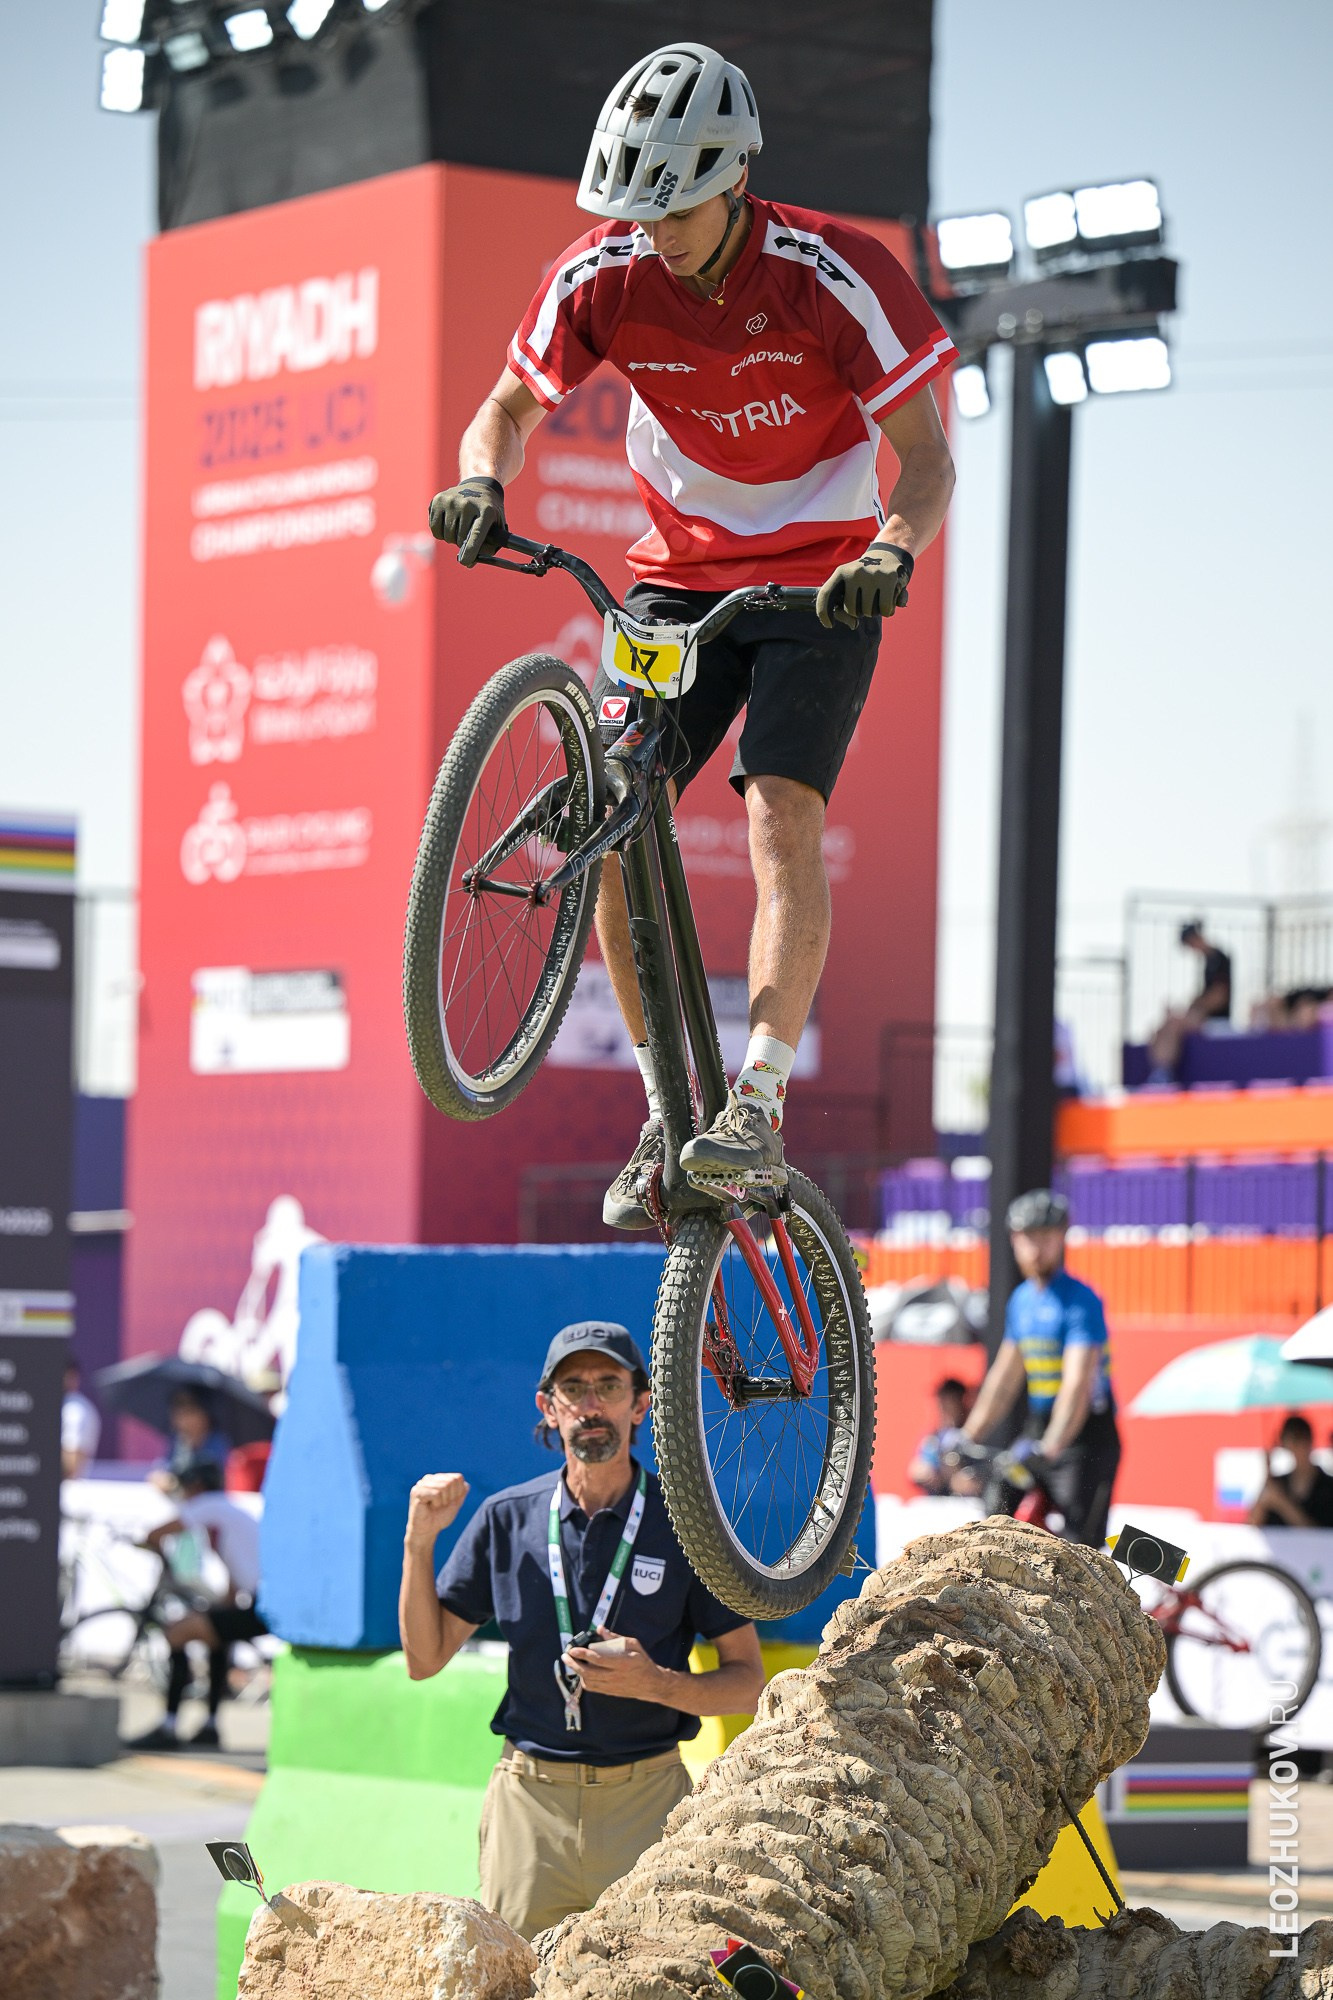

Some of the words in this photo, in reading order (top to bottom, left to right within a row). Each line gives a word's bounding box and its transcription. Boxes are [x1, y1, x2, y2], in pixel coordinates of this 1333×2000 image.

[774, 236, 856, 288] FELT
[193, 265, 379, 391] RIYADH
[627, 361, 697, 373] FELT
[731, 351, 804, 376] CHAOYANG
[630, 646, 659, 675] 17
